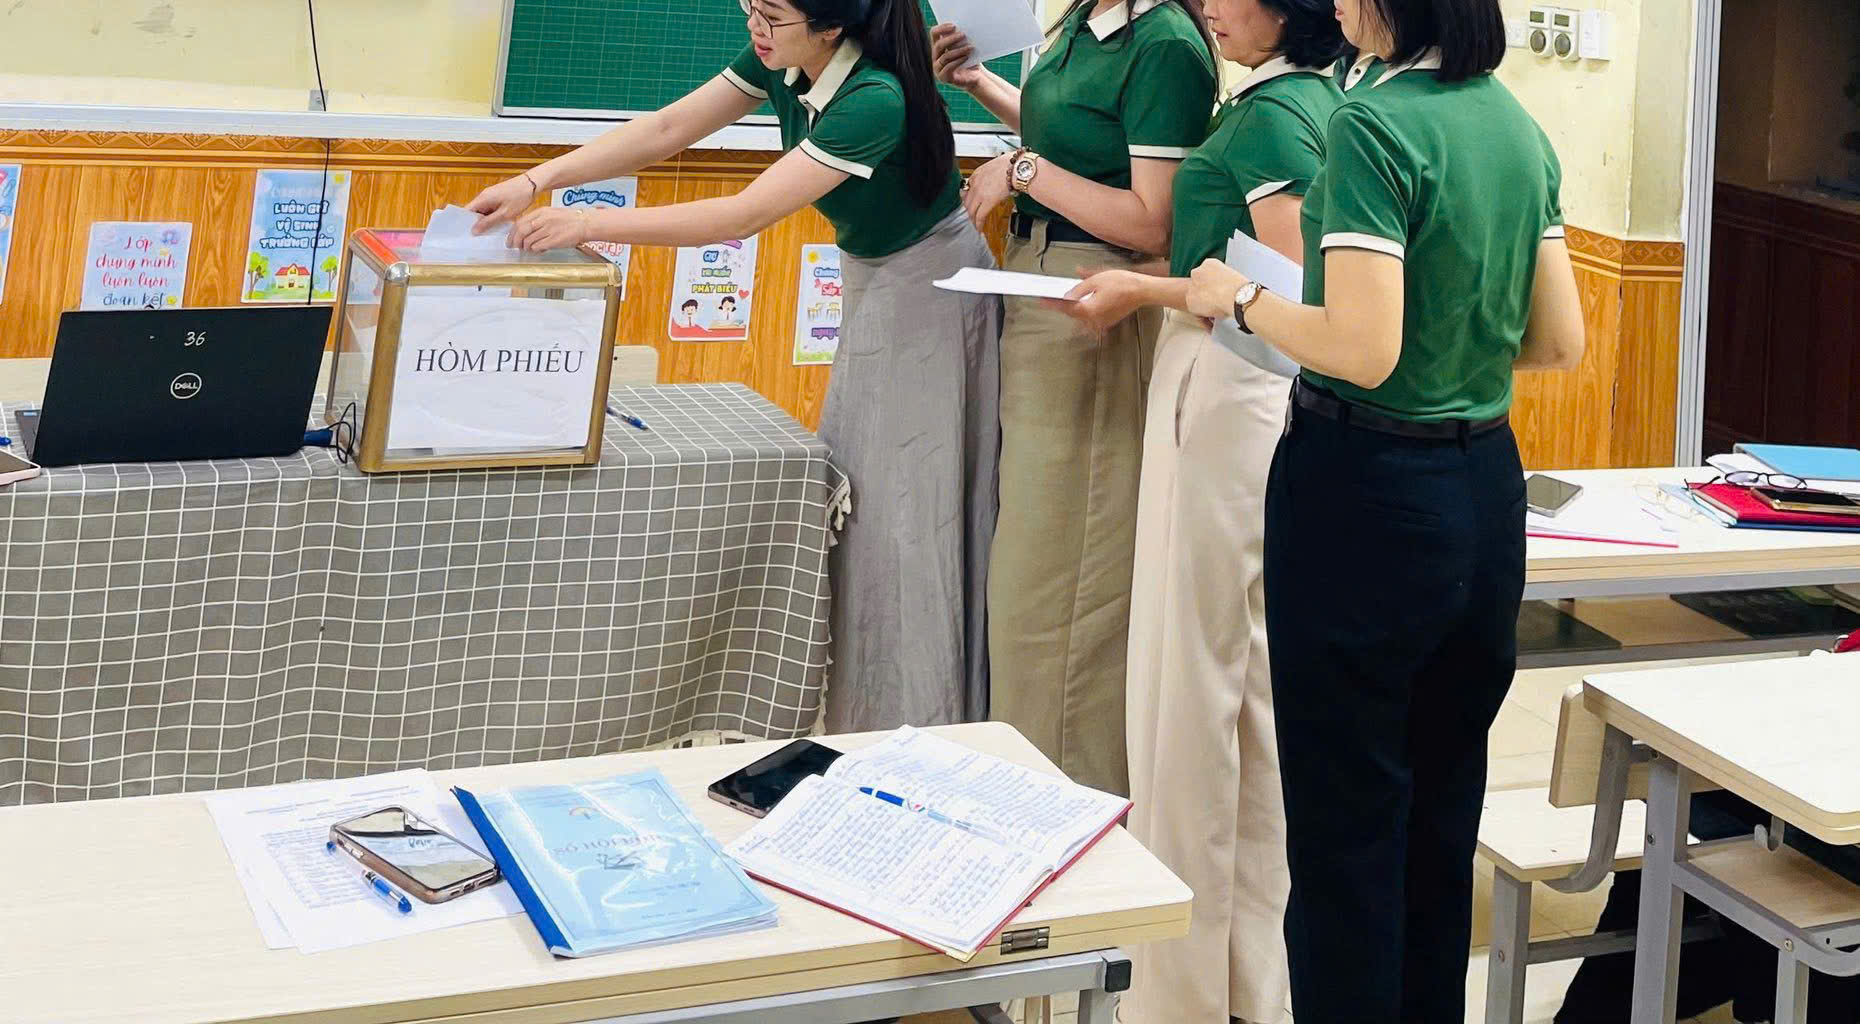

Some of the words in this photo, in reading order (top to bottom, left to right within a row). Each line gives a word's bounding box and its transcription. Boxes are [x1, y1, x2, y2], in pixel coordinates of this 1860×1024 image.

[273, 199, 306, 215] LUÔN
[276, 217, 292, 233] VỆ
[259, 233, 310, 250] TRƯỜNG
[691, 282, 715, 294] PHÁT
[183, 331, 206, 347] 36
[415, 341, 489, 373] HÒM
[496, 341, 585, 374] PHIẾU
